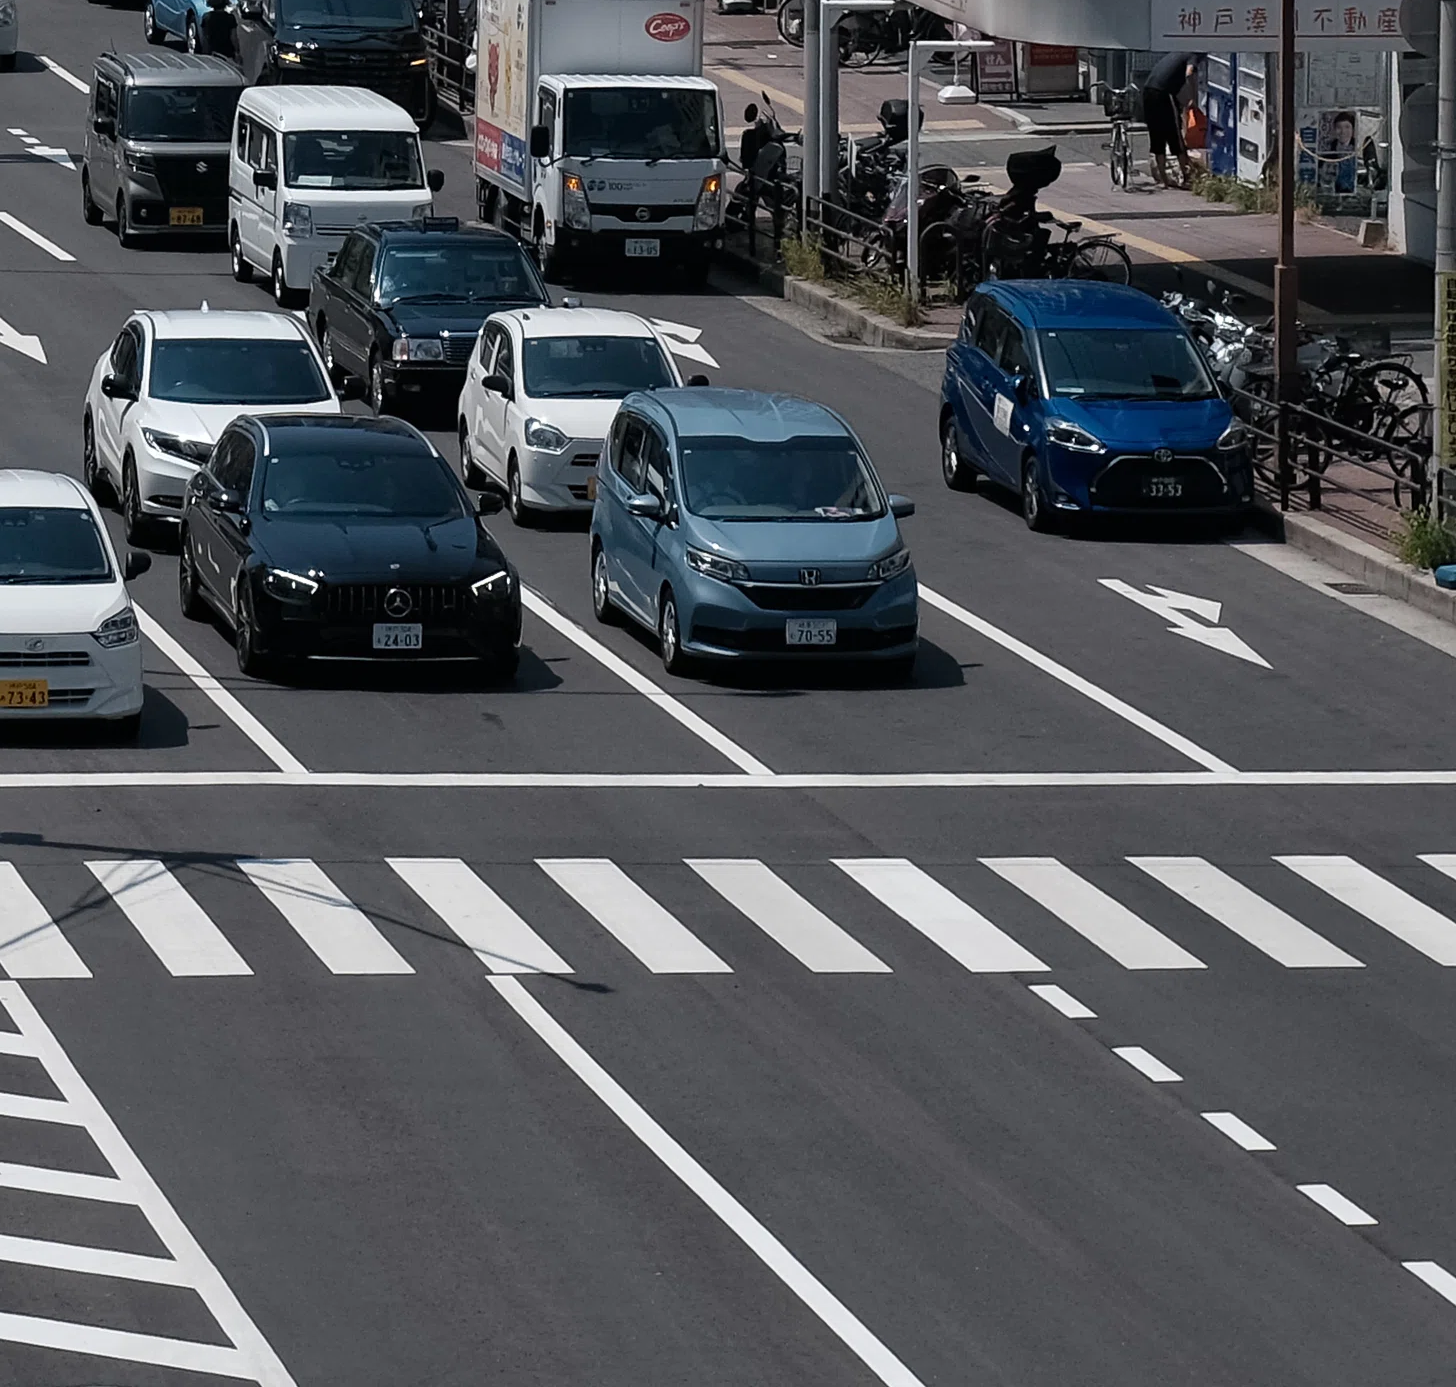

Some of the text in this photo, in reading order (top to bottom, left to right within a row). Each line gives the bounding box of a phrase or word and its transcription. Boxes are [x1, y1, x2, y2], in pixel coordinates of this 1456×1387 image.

[1178, 6, 1398, 34] 神戸湊不動産
[384, 633, 420, 647] 24-03
[797, 629, 833, 643] 70-55
[7, 691, 45, 705] 73-43
